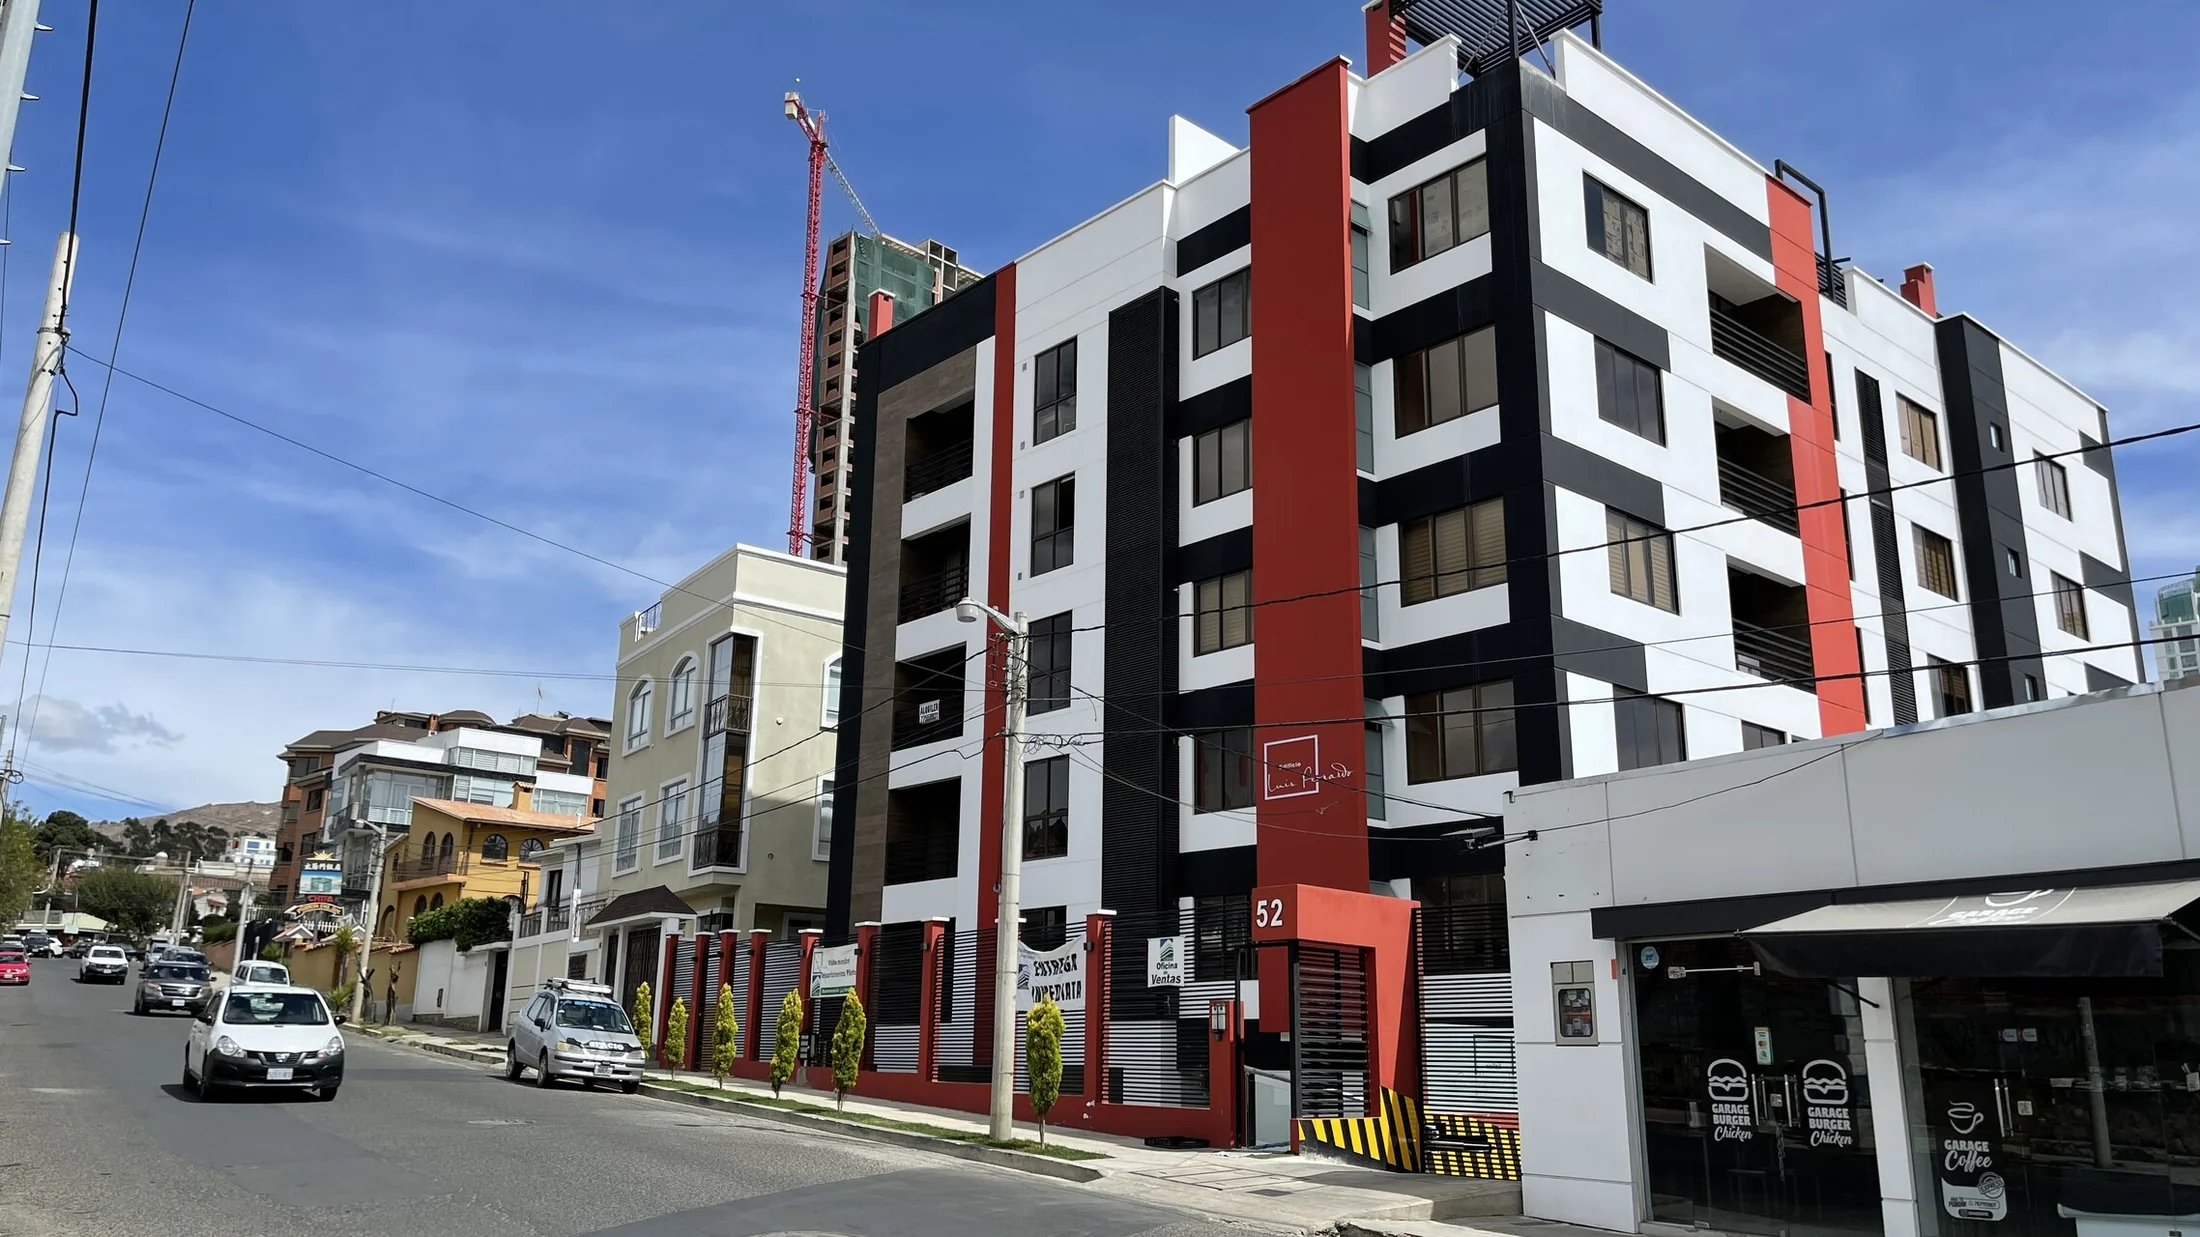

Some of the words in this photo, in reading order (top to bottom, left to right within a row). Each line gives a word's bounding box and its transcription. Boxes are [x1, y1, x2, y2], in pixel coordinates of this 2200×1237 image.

[920, 702, 939, 715] ALQUILER
[1268, 774, 1297, 792] Luis
[1256, 899, 1283, 928] 52
[1948, 906, 2039, 919] GARAGE
[1033, 953, 1078, 977] ENTREGA
[1156, 962, 1178, 971] Oficina
[1151, 974, 1182, 985] Ventas
[1711, 1103, 1750, 1115] GARAGE
[1807, 1106, 1850, 1119] GARAGE
[1712, 1114, 1752, 1126] BURGER
[1808, 1118, 1852, 1131] BURGER
[1714, 1125, 1754, 1142] Chicken
[1810, 1130, 1854, 1147] Chicken
[1944, 1139, 1990, 1152] GARAGE
[1944, 1149, 1993, 1173] Coffee
